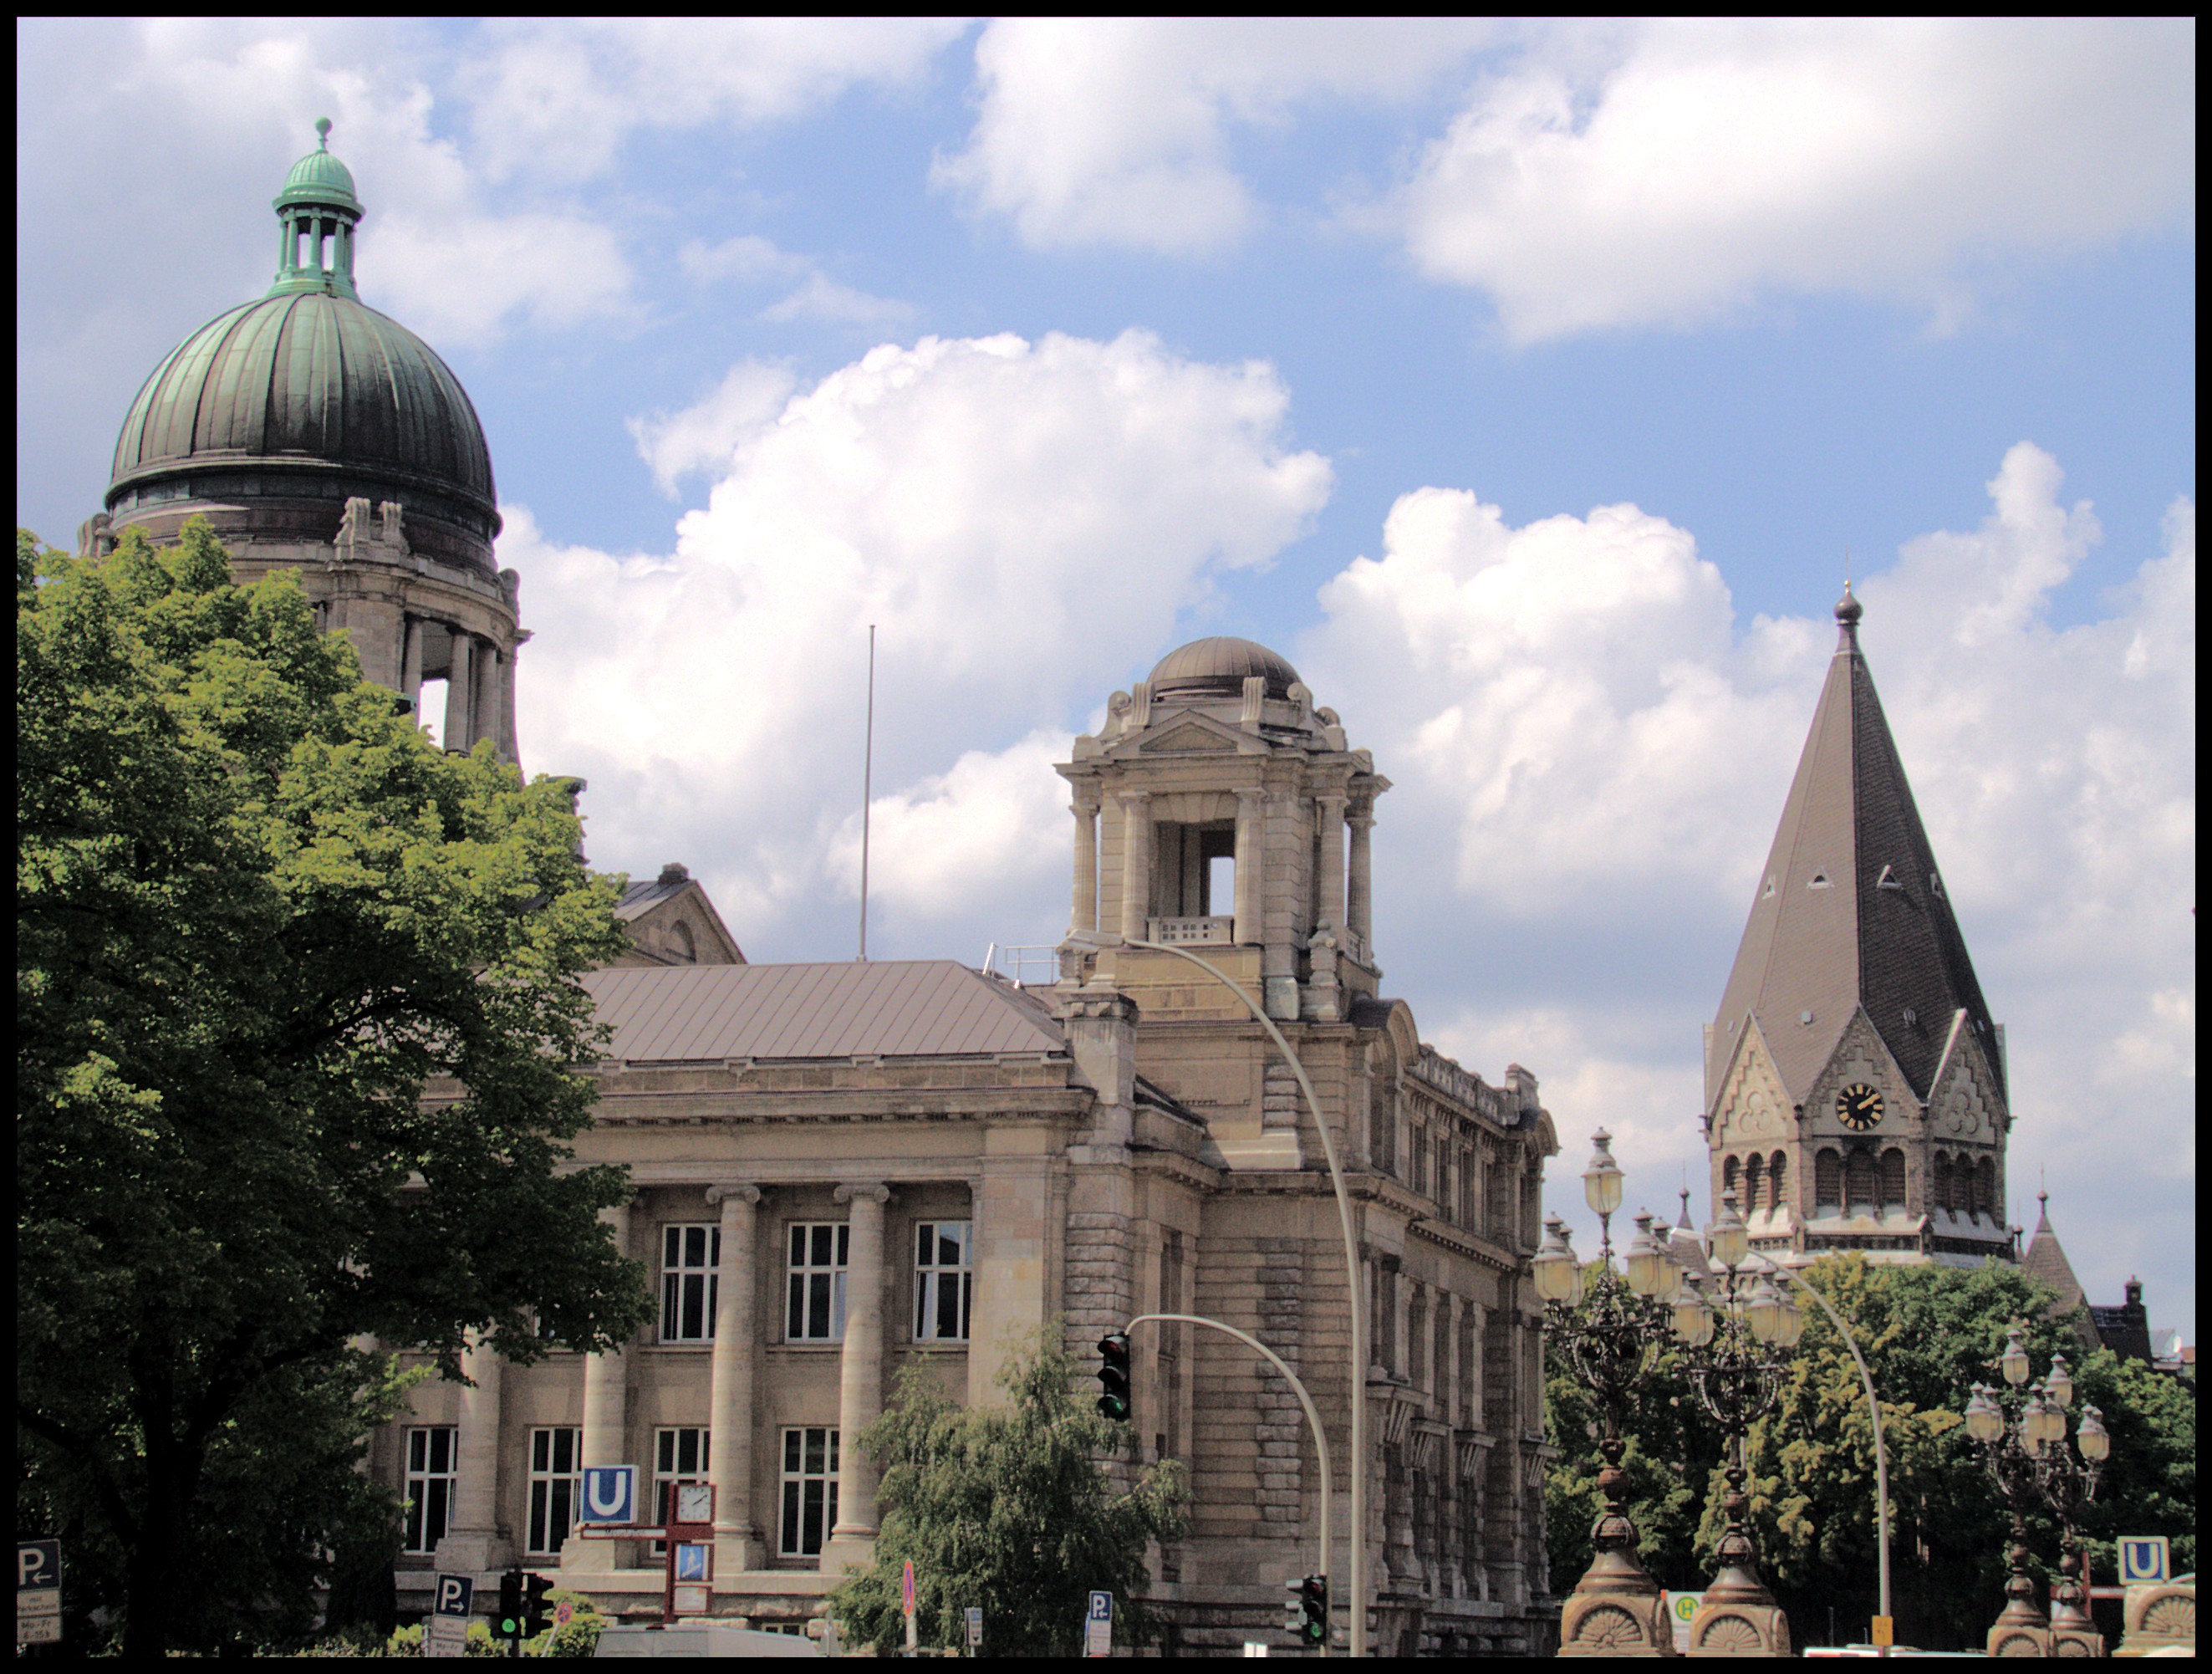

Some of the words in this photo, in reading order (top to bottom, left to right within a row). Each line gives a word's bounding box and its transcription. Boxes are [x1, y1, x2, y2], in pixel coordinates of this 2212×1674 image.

[589, 1471, 626, 1516] U
[18, 1548, 45, 1585] P
[2128, 1543, 2159, 1578] U
[441, 1579, 462, 1610] P
[1093, 1595, 1106, 1619] P
[1681, 1601, 1694, 1616] H
